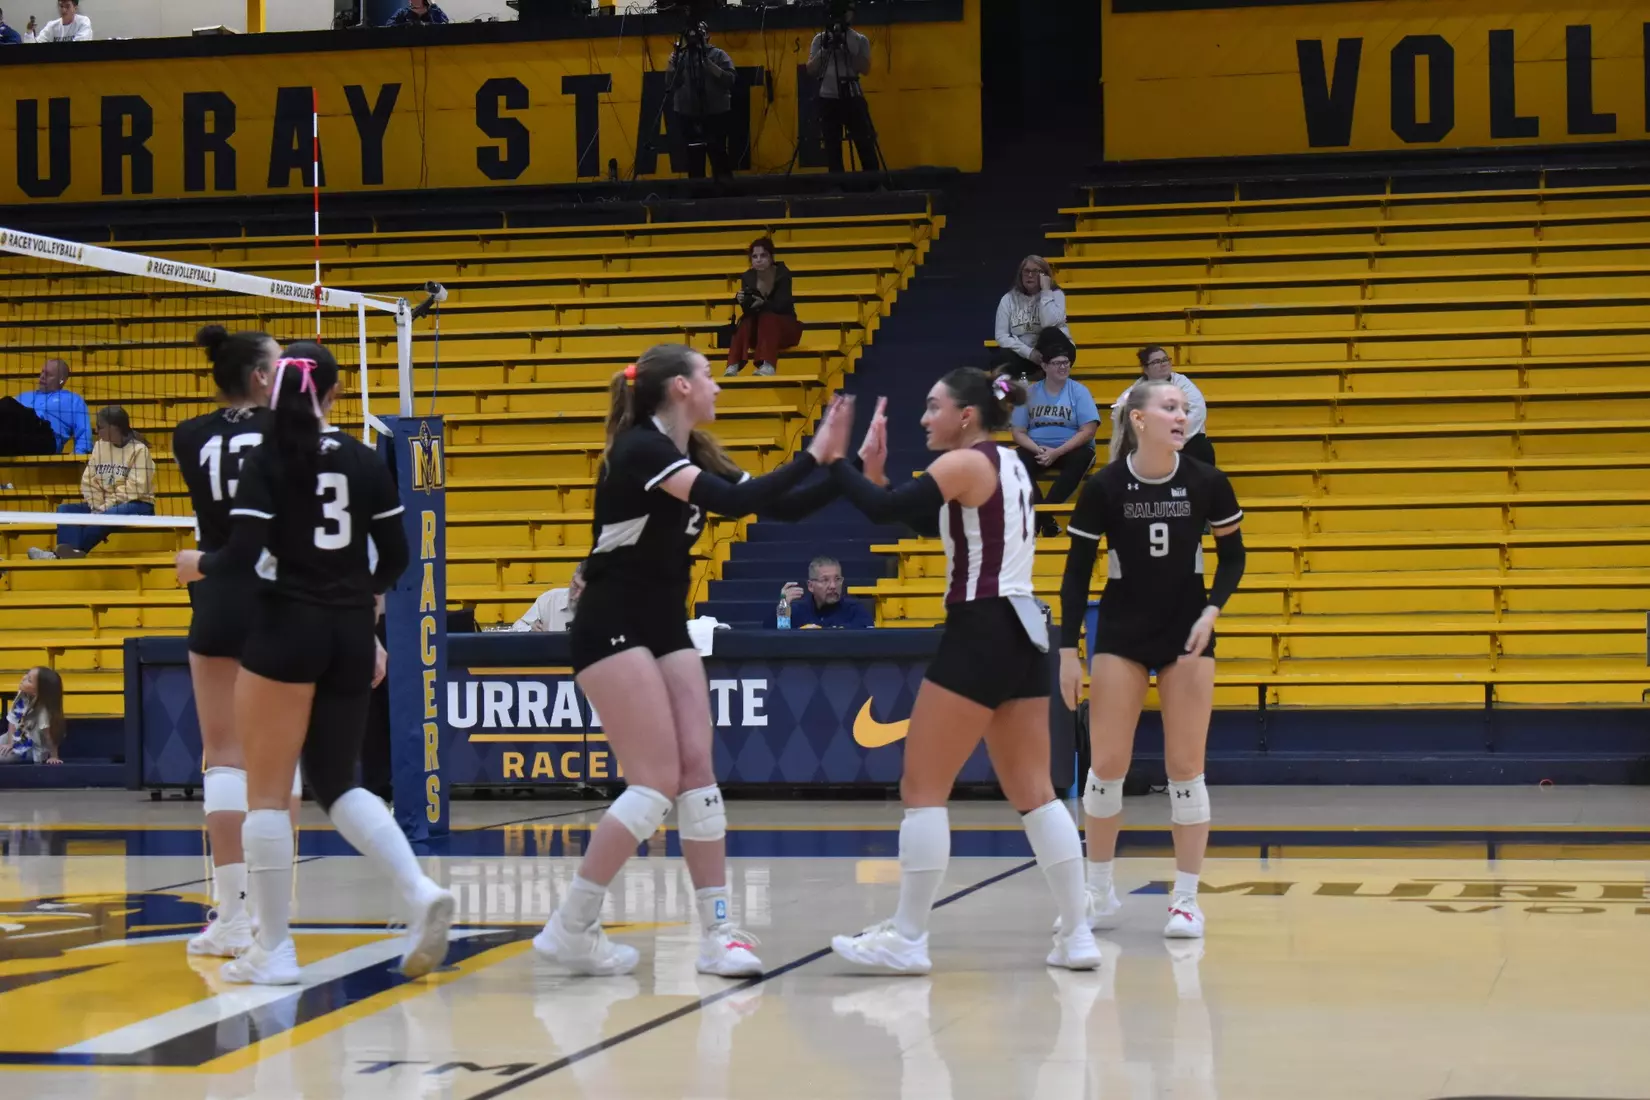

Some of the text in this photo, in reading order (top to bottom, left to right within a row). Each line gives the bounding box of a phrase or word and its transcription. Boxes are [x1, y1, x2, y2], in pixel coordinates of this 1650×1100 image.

[1297, 22, 1650, 147] VOLL
[16, 83, 402, 197] URRAY
[9, 232, 77, 258] RACER VOLLEYBALL
[153, 261, 212, 282] RACER VOLLEYBALL
[275, 282, 324, 300] RACER VOLLEYBL
[314, 472, 351, 550] 3
[1123, 501, 1191, 518] SALUKIS
[1149, 522, 1169, 557] 9
[420, 510, 441, 823] RACERS
[709, 679, 768, 727] TE
[503, 751, 624, 778] RACE
[1425, 905, 1650, 916] VO
[355, 1060, 539, 1076] TM
